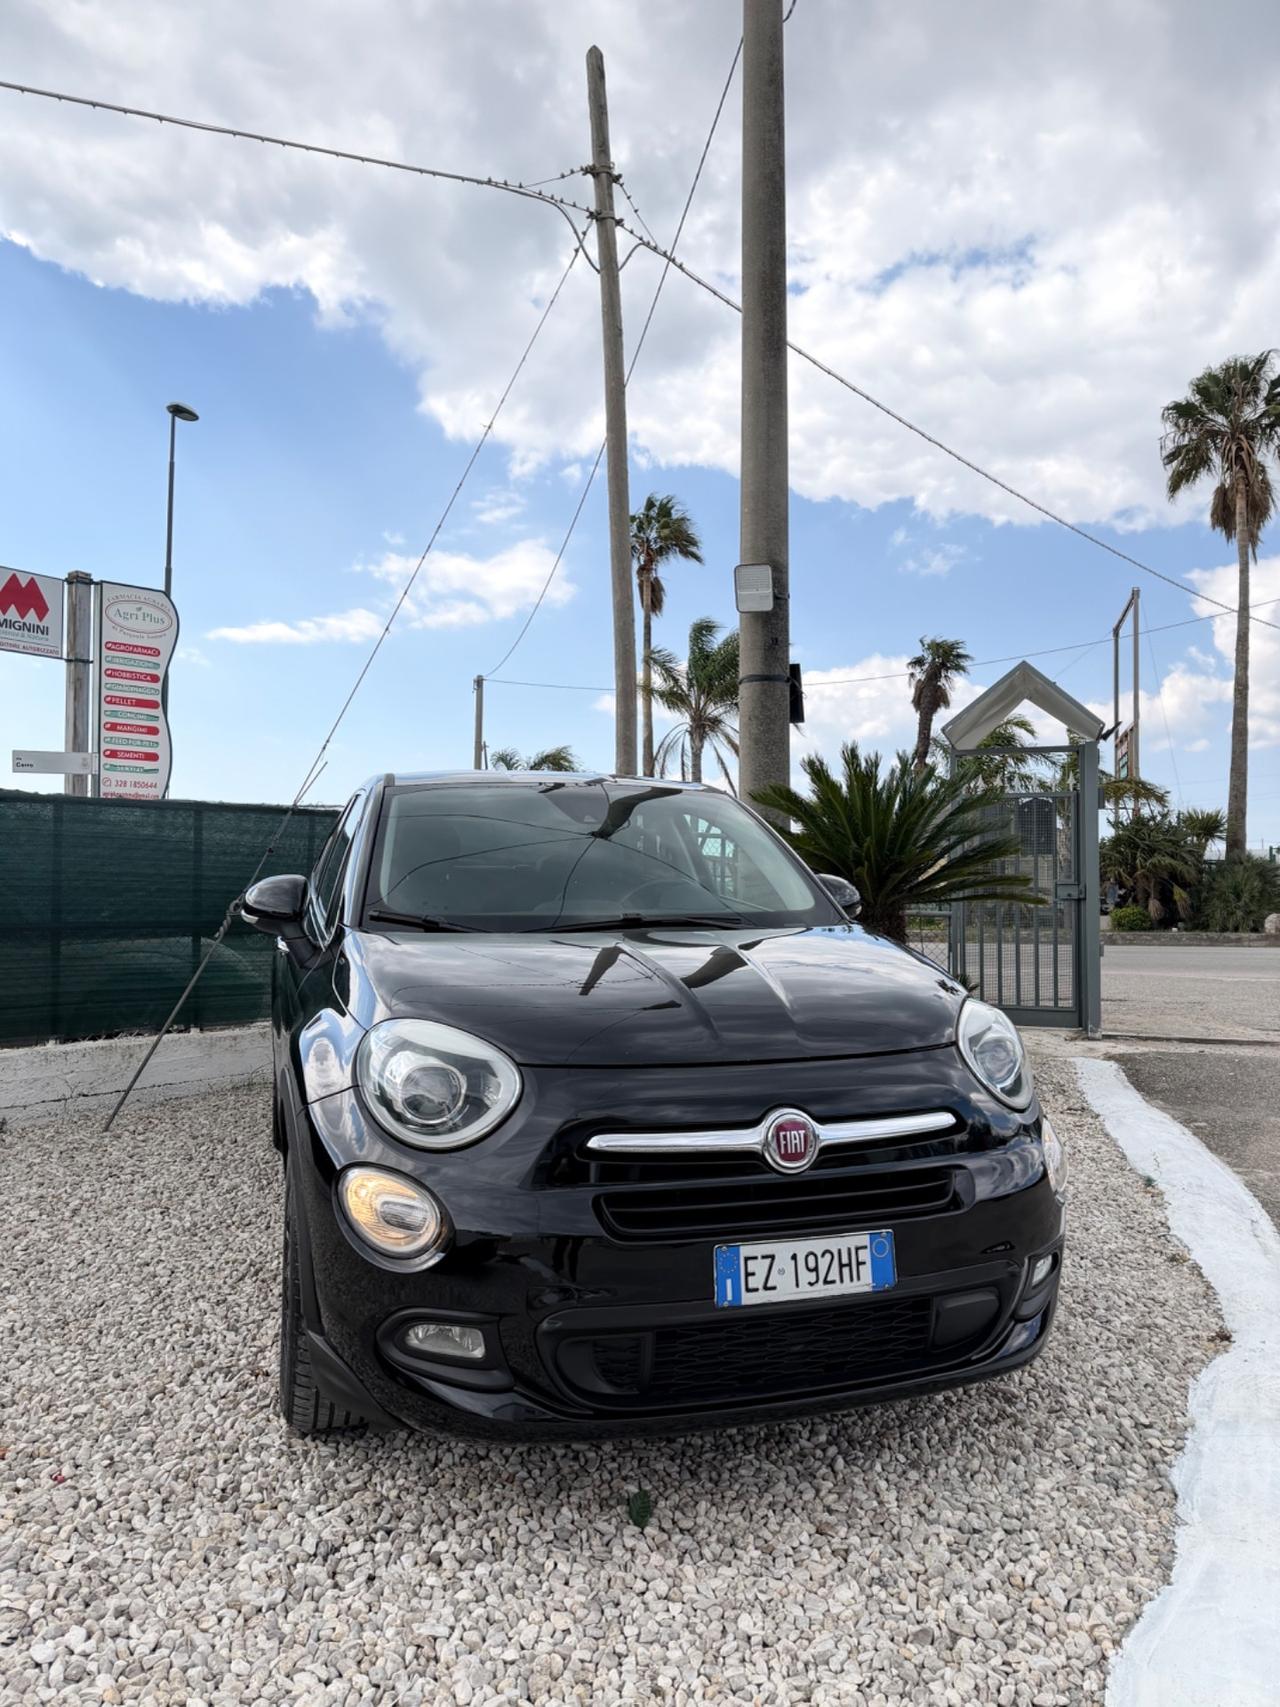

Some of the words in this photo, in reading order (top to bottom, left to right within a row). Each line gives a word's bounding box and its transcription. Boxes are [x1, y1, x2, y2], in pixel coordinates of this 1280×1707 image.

[113, 607, 138, 621] Agri
[142, 612, 165, 625] Plus
[0, 618, 49, 636] MIGNINI
[111, 643, 159, 656] AGROFARMACI
[111, 670, 152, 681] HOBBISTICA
[111, 697, 136, 706] PELLET
[116, 724, 148, 734] MANGIMI
[116, 751, 145, 760] SEMENTI
[114, 779, 128, 788] 328
[779, 1130, 806, 1154] FIAT
[743, 1254, 777, 1293] EZ
[790, 1245, 868, 1288] 192HF
